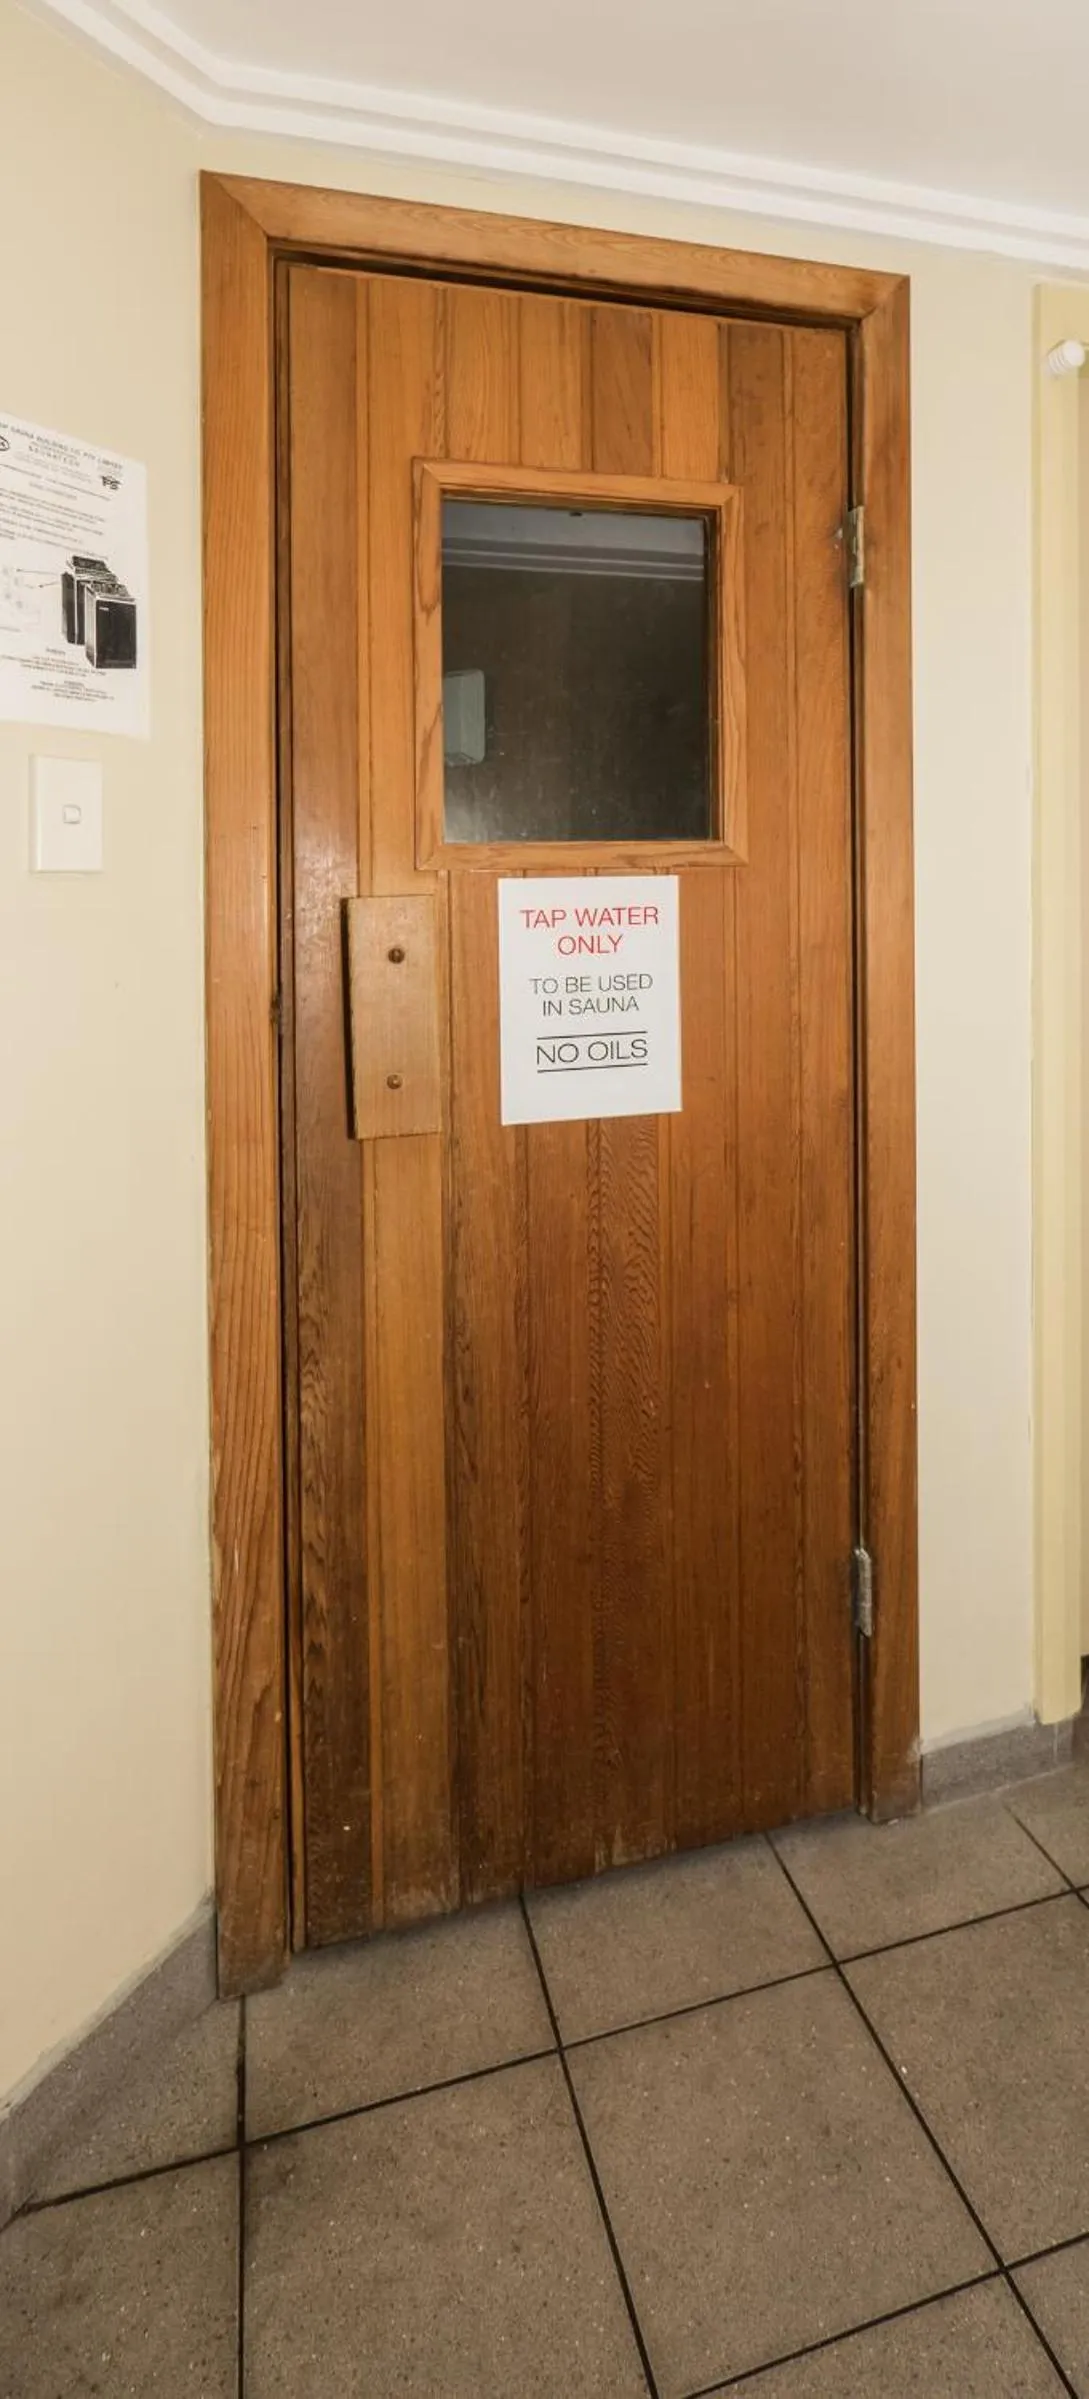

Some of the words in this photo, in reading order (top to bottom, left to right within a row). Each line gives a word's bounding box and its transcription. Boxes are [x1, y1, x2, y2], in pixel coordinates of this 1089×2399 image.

[519, 909, 567, 929] TAP
[574, 905, 660, 928] WATER
[557, 934, 624, 956] ONLY
[530, 977, 559, 995] TO
[565, 976, 592, 994] BE
[598, 973, 654, 993] USED
[542, 999, 563, 1017] IN
[568, 995, 640, 1017] SAUNA
[536, 1042, 579, 1065] NO
[587, 1038, 649, 1062] OILS
